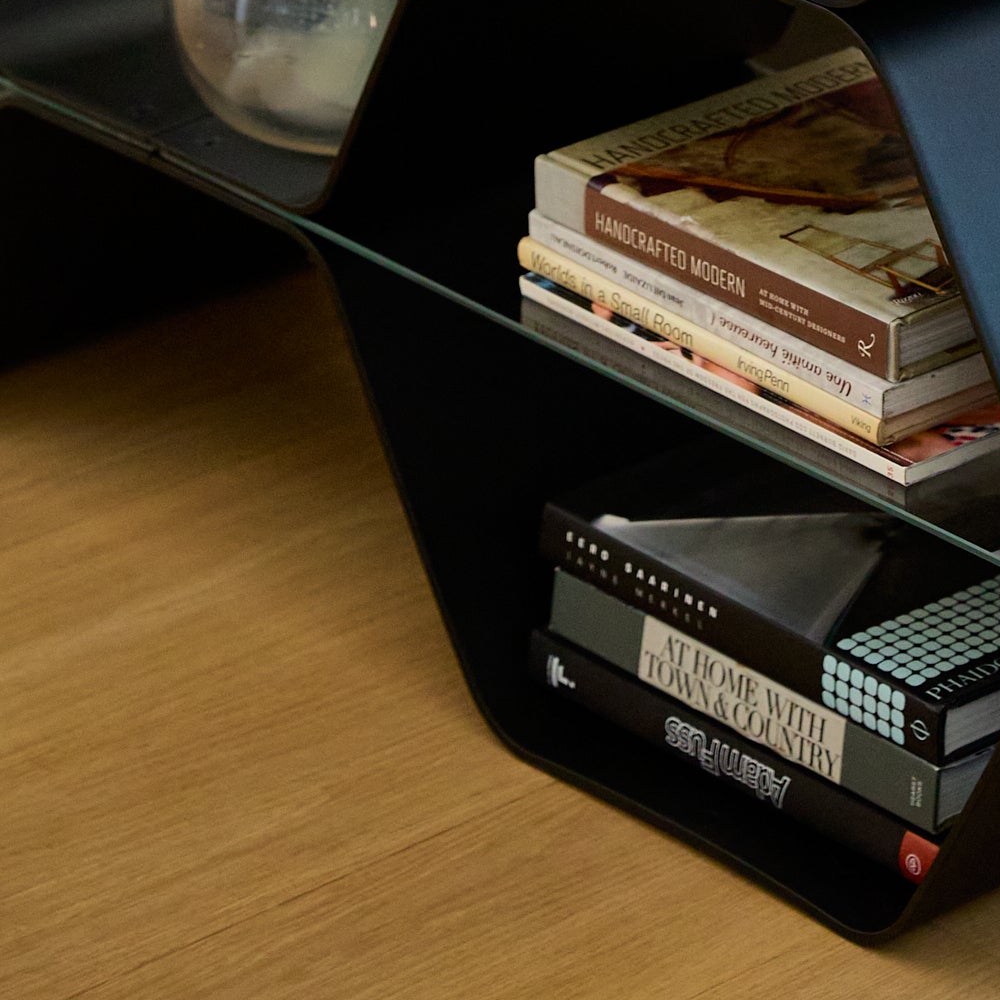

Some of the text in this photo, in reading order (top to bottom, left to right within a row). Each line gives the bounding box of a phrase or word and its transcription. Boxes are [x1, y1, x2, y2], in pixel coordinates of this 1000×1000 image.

[582, 91, 778, 169] HANDCRAFTED
[595, 211, 746, 298] HANDCRAFTED MODERN
[530, 251, 577, 288] Worlds
[581, 277, 593, 296] in
[598, 290, 606, 303] a
[611, 292, 650, 328] Small
[653, 313, 694, 347] Room
[758, 288, 809, 316] AT HOME WITH
[758, 299, 846, 344] MID-CENTURY DESIGNERS
[719, 316, 852, 397] Une amitié heureuse
[851, 415, 872, 433] Viking
[566, 531, 718, 619] EERO SAARINEN
[644, 651, 840, 778] TOWN & COUNTRY
[660, 635, 827, 743] AT HOME WITH
